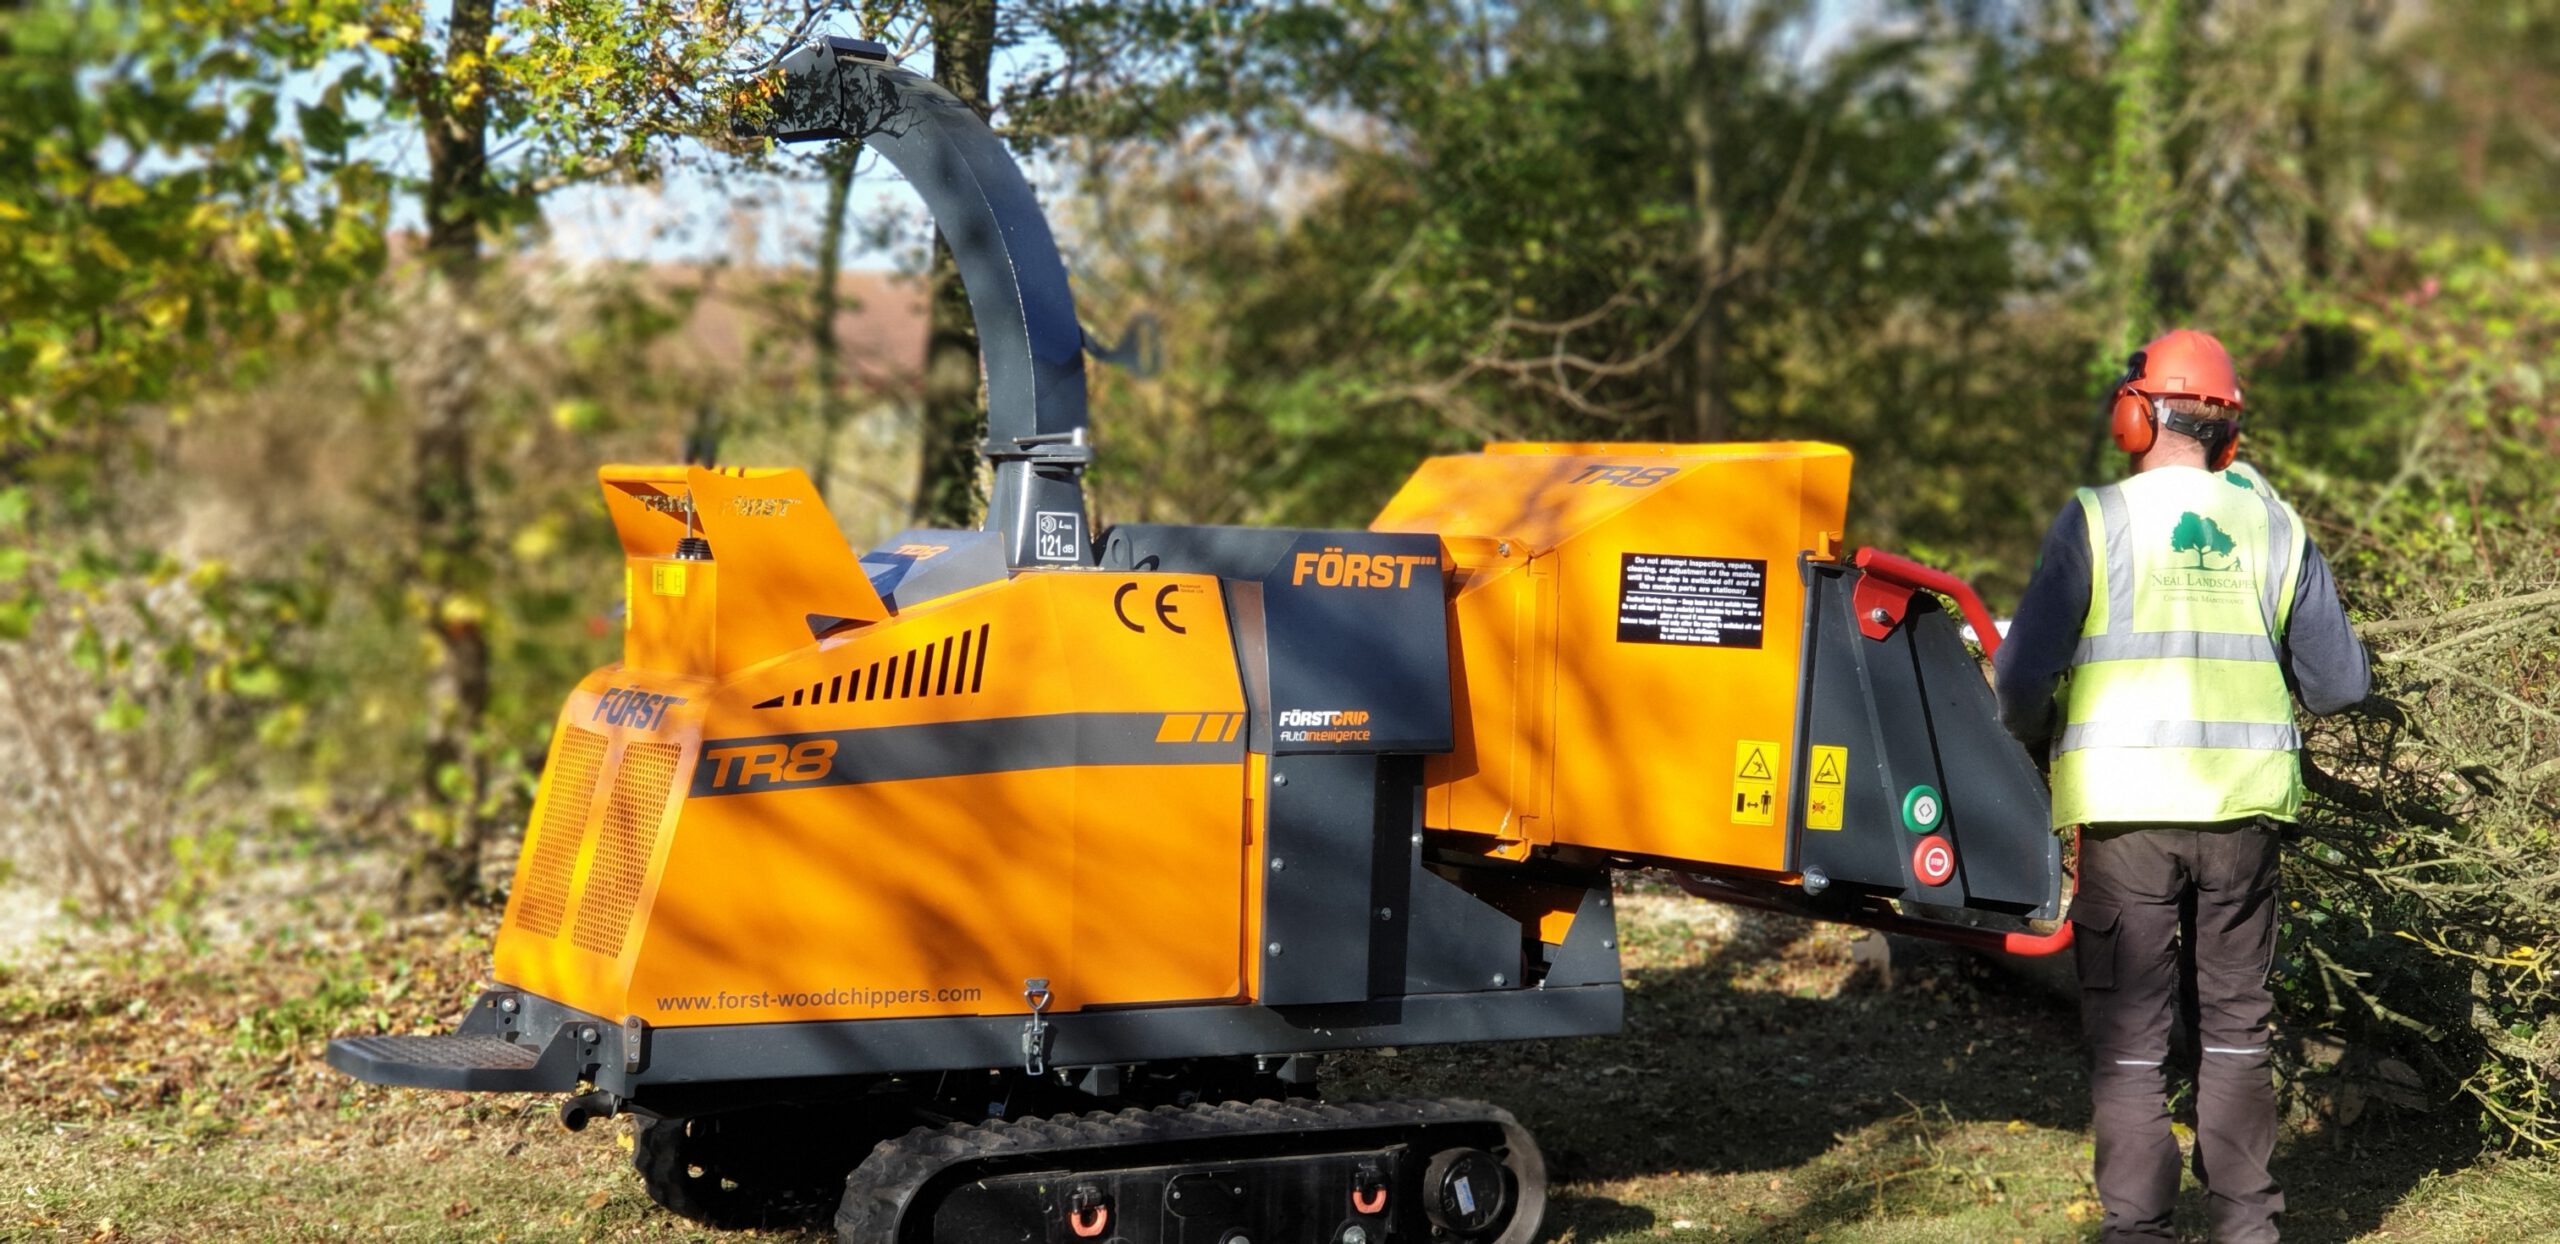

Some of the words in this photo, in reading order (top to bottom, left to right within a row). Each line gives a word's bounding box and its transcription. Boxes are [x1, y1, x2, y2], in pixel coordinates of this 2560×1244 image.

[1568, 465, 1680, 487] TR8
[1041, 534, 1061, 556] 121
[1062, 544, 1075, 553] dB
[1292, 547, 1425, 588] FÖRST
[1634, 556, 1646, 564] Do
[1647, 557, 1659, 565] not
[1660, 558, 1688, 567] attempt
[1669, 567, 1707, 576] adjustment
[1719, 569, 1730, 577] the
[1732, 570, 1761, 578] machine
[1639, 582, 1651, 590] the
[1652, 584, 1677, 592] moving
[1678, 584, 1697, 593] parts
[1712, 586, 1747, 595] stationary
[1644, 574, 1656, 582] the
[1657, 576, 1680, 584] engine
[1690, 577, 1721, 585] switched
[1723, 578, 1734, 586] off
[1735, 579, 1749, 587] and
[1751, 579, 1760, 587] all
[2152, 574, 2183, 586] NEAL
[2186, 573, 2257, 589] LANDSCAPES
[592, 684, 679, 731] FÖRST
[706, 739, 838, 788] TR8
[656, 986, 982, 1011] www.forst-woodchippers.com
